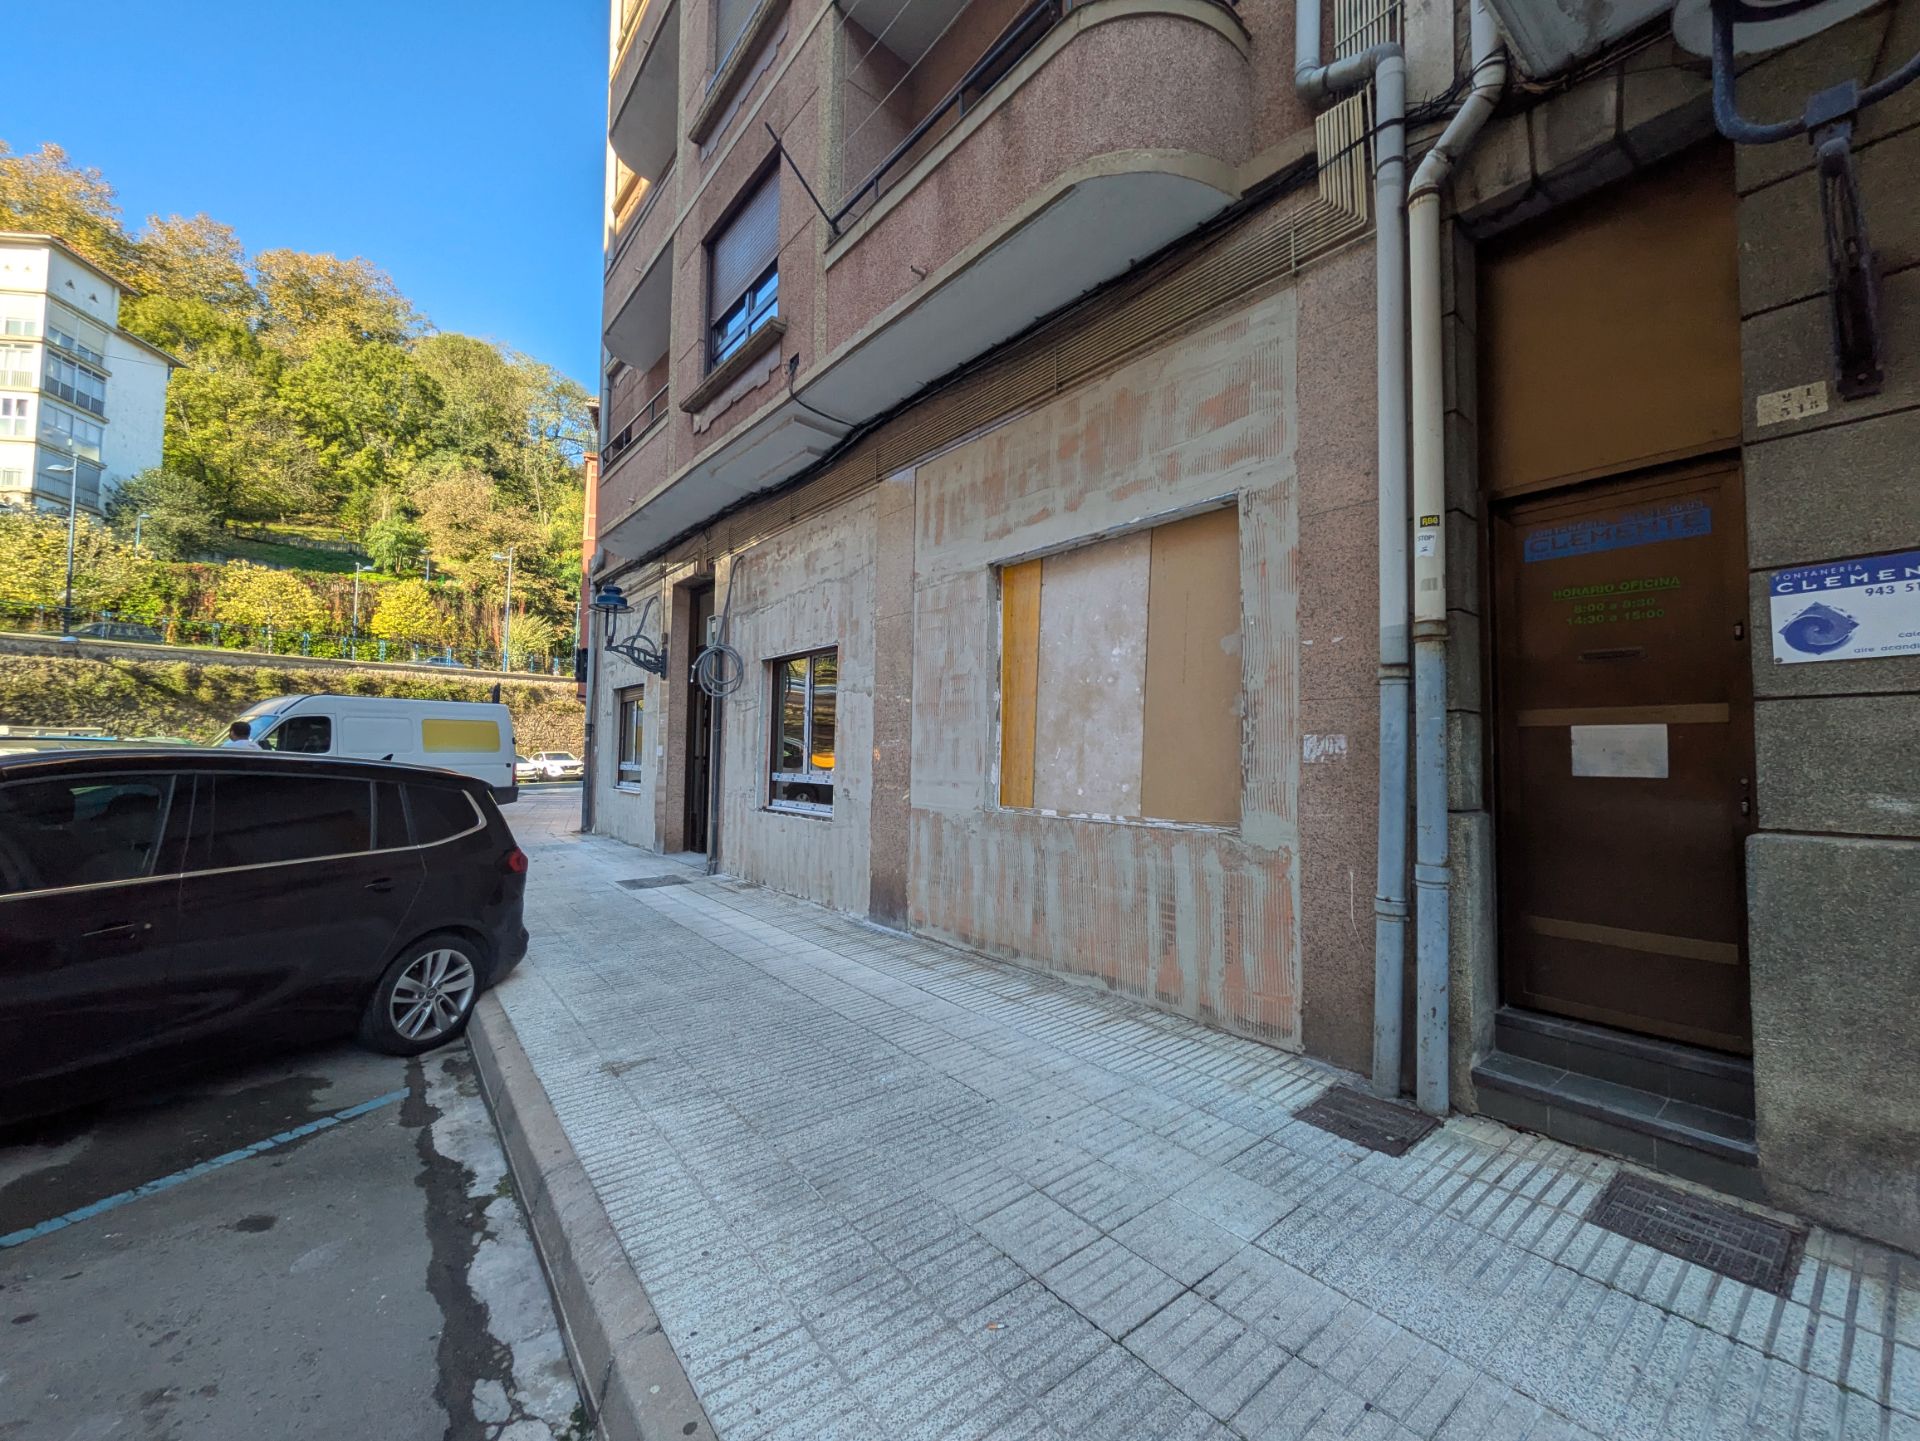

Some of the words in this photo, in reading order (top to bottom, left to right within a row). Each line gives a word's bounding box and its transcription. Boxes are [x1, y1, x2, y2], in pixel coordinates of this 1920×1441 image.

[1528, 511, 1704, 553] CLEMENTE
[1552, 584, 1615, 599] HORARIO
[1619, 576, 1680, 591] OFICINA
[1865, 585, 1896, 597] 943
[1574, 603, 1605, 614] 8:00
[1567, 614, 1605, 625] 14:30
[1625, 609, 1665, 621] 15:00
